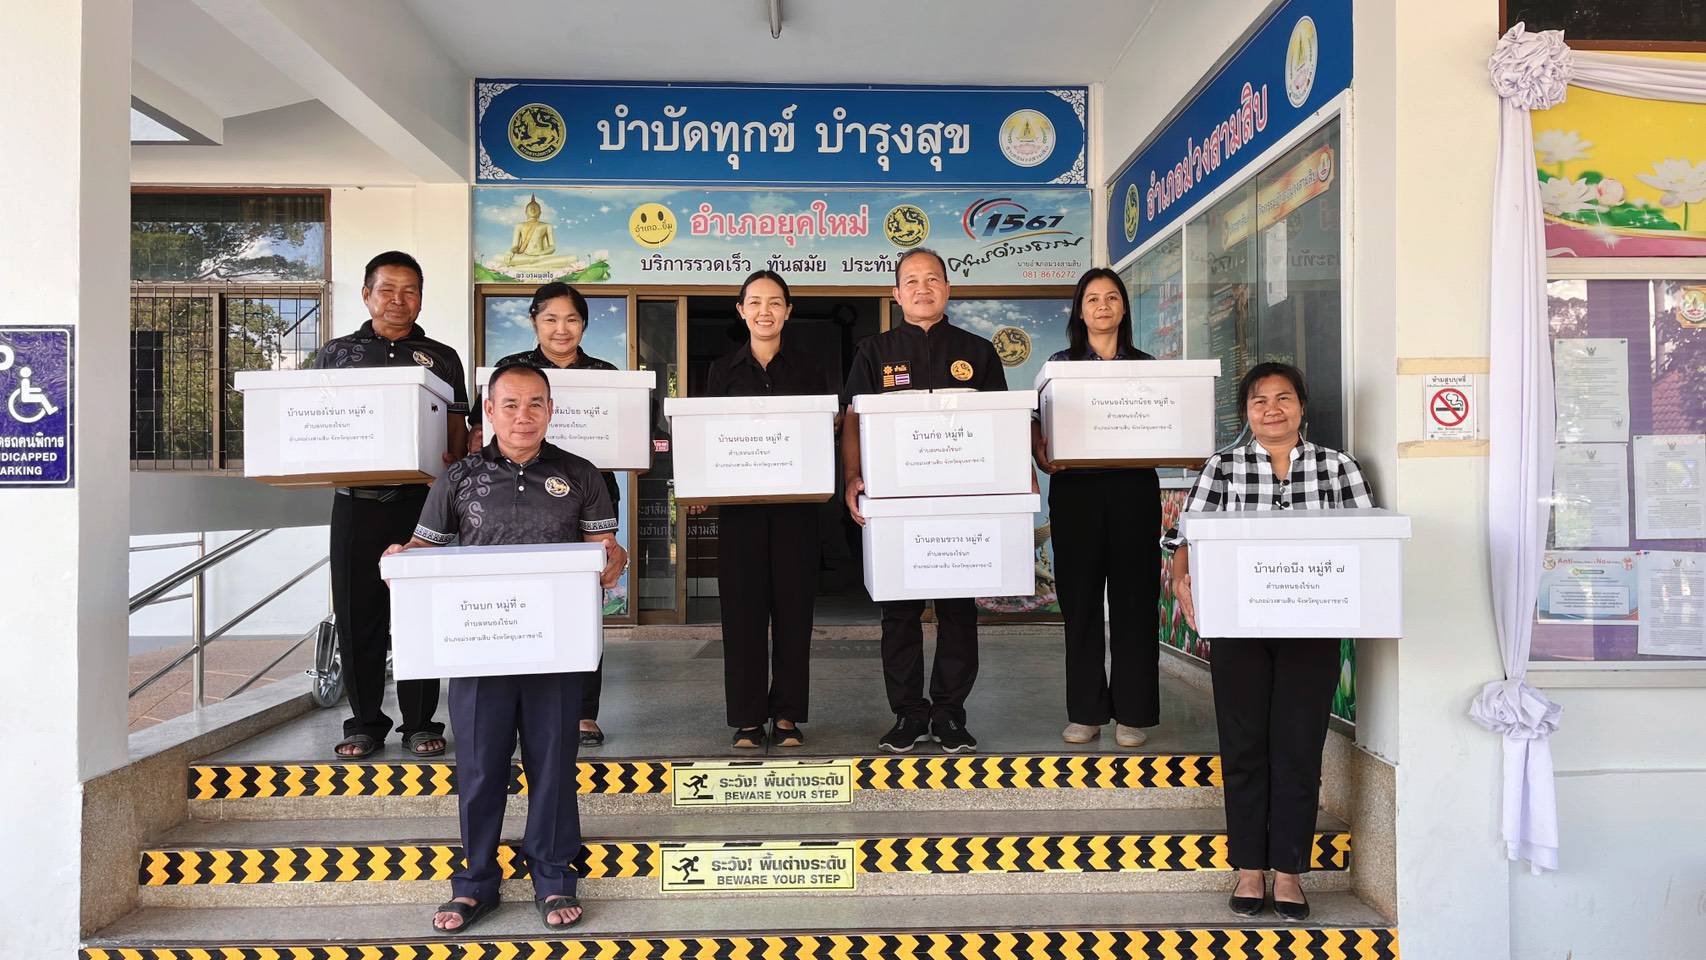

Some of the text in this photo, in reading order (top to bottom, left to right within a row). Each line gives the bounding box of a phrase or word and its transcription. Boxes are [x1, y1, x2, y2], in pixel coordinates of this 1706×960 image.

[597, 104, 970, 172] บำบัดทุกข์ บำรุงสุข
[1147, 81, 1268, 222] อำเภอม่วงสามสิบ
[690, 200, 869, 247] อำเภอยุคใหม่
[982, 214, 1065, 237] 1567
[641, 252, 903, 273] บริการรวดเร็ว ทันสมัย ประทับ
[1432, 375, 1466, 384] ห้ามสูบบุหรี่
[1154, 397, 1168, 407] หมู่ที่
[288, 407, 346, 417] บ้านหนองไข่นก
[348, 406, 366, 417] หมู่ที่
[554, 406, 581, 415] ส้มป่อย
[583, 404, 600, 417] หมู่ที่
[765, 432, 782, 444] หมู่ที่
[912, 430, 942, 440] บ้านก่อ
[945, 426, 964, 441] หมู่ที่
[0, 452, 58, 462] DICAPPED
[0, 466, 43, 476] ARKING
[966, 532, 983, 545] หมู่ที่
[1254, 562, 1304, 574] บ้านก่อบึง
[1308, 560, 1332, 577] หมู่ที่
[1266, 581, 1320, 590] ตำบลหนองไข่นก
[460, 600, 493, 611] บ้านบก
[496, 597, 517, 612] หมู่ที่
[719, 770, 844, 788] ระวัง! พื้นต่างระดับ
[725, 790, 839, 800] BEWARE YOUR STEP
[711, 852, 847, 872] ระวัง! พื้นต่างระดับ
[717, 874, 841, 885] BEWARE YOUR STEP
